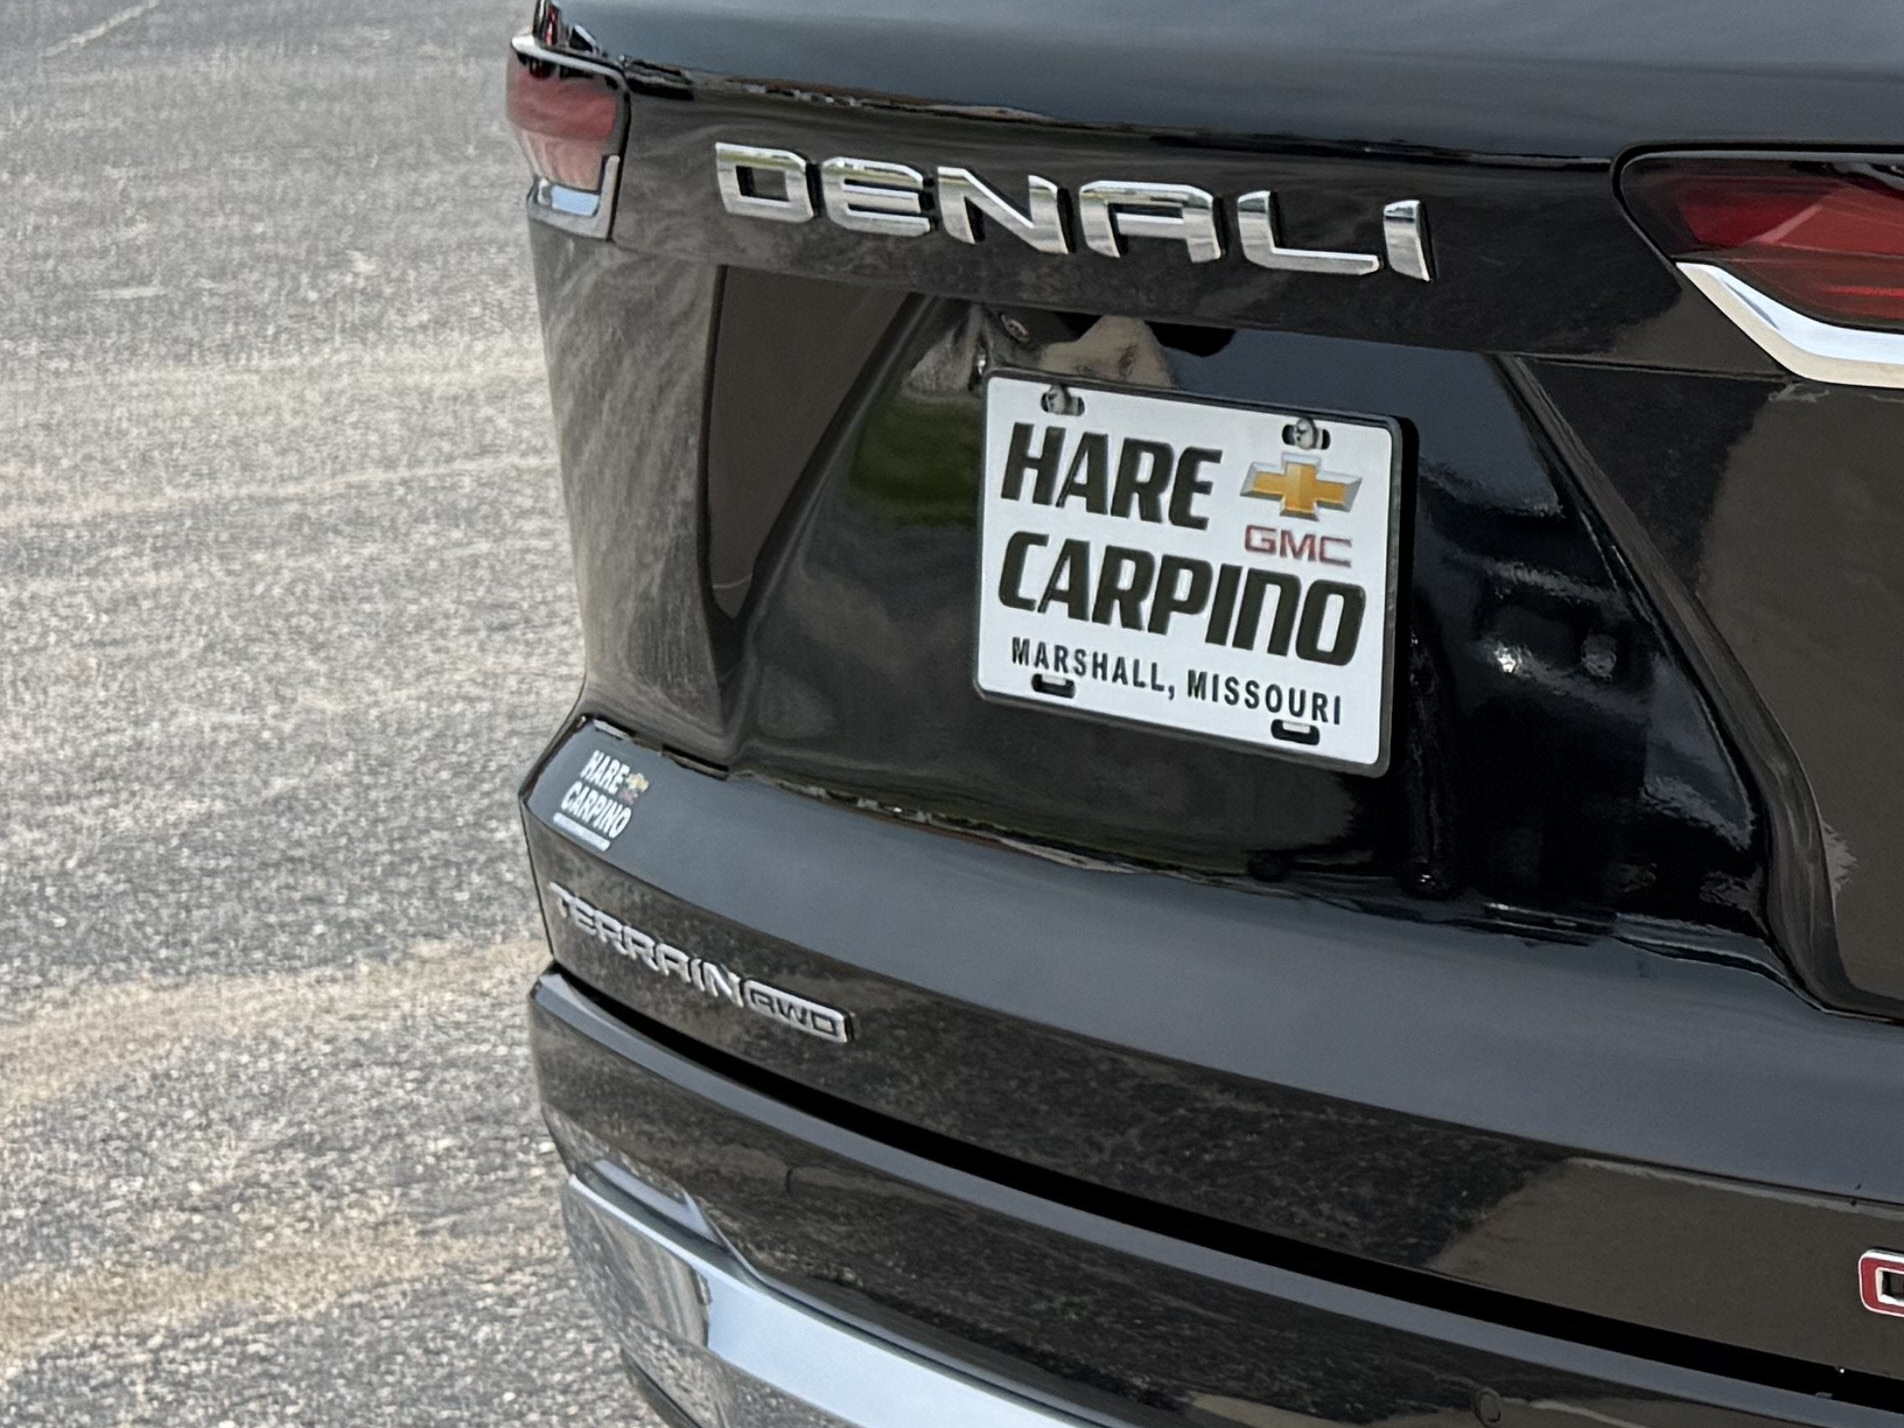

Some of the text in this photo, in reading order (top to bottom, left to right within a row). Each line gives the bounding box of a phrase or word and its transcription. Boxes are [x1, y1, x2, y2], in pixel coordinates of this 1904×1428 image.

[714, 141, 1432, 282] DENALI
[1001, 422, 1223, 531] HARE
[1244, 524, 1352, 568] GMC
[998, 530, 1367, 667] CARPINO
[1011, 637, 1342, 725] MARSHALL, MISSOURI
[561, 781, 632, 839] CARPINO
[580, 750, 630, 794] HARE
[550, 881, 744, 1008] TERRAIN
